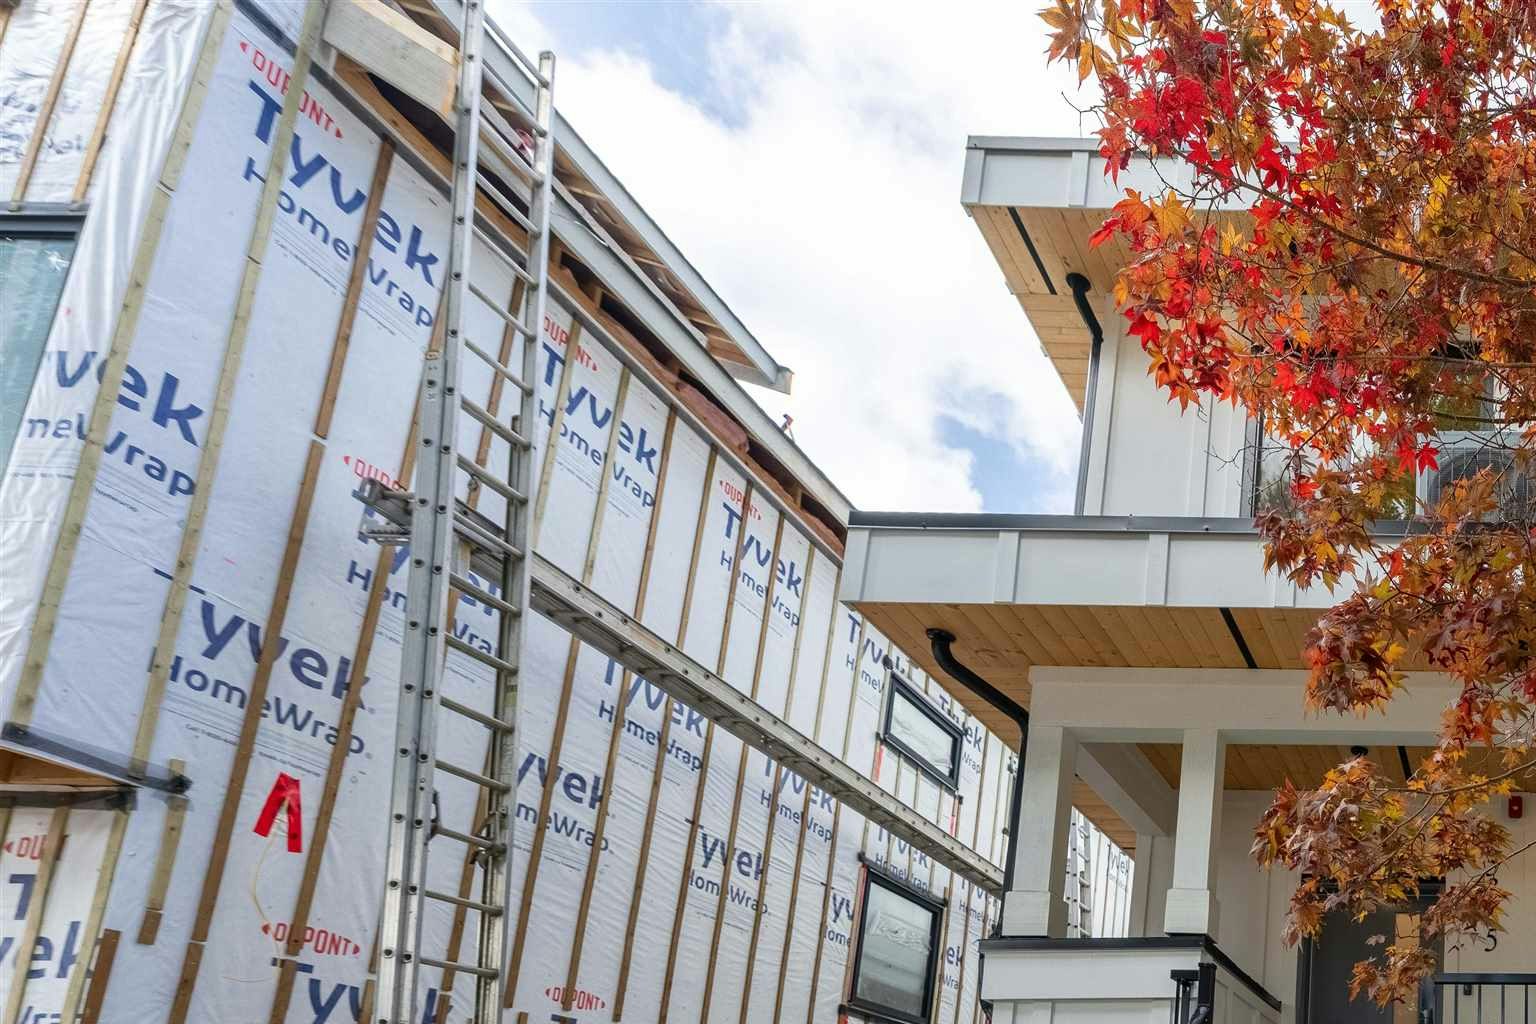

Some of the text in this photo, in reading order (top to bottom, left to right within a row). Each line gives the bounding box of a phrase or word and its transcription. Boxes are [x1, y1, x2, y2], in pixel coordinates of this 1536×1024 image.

[249, 80, 439, 286] Tyvek
[543, 317, 592, 368] DUPNT
[57, 351, 204, 447] vek
[543, 341, 657, 475] Tyvek
[724, 484, 758, 519] DUPT
[720, 550, 799, 626] Hmerap
[599, 701, 702, 771] Hmerap
[517, 752, 612, 816] yvek
[516, 803, 608, 851] mWrap
[761, 790, 832, 842] Hmerap
[690, 869, 768, 914] omWrap
[274, 923, 352, 956] DPONT
